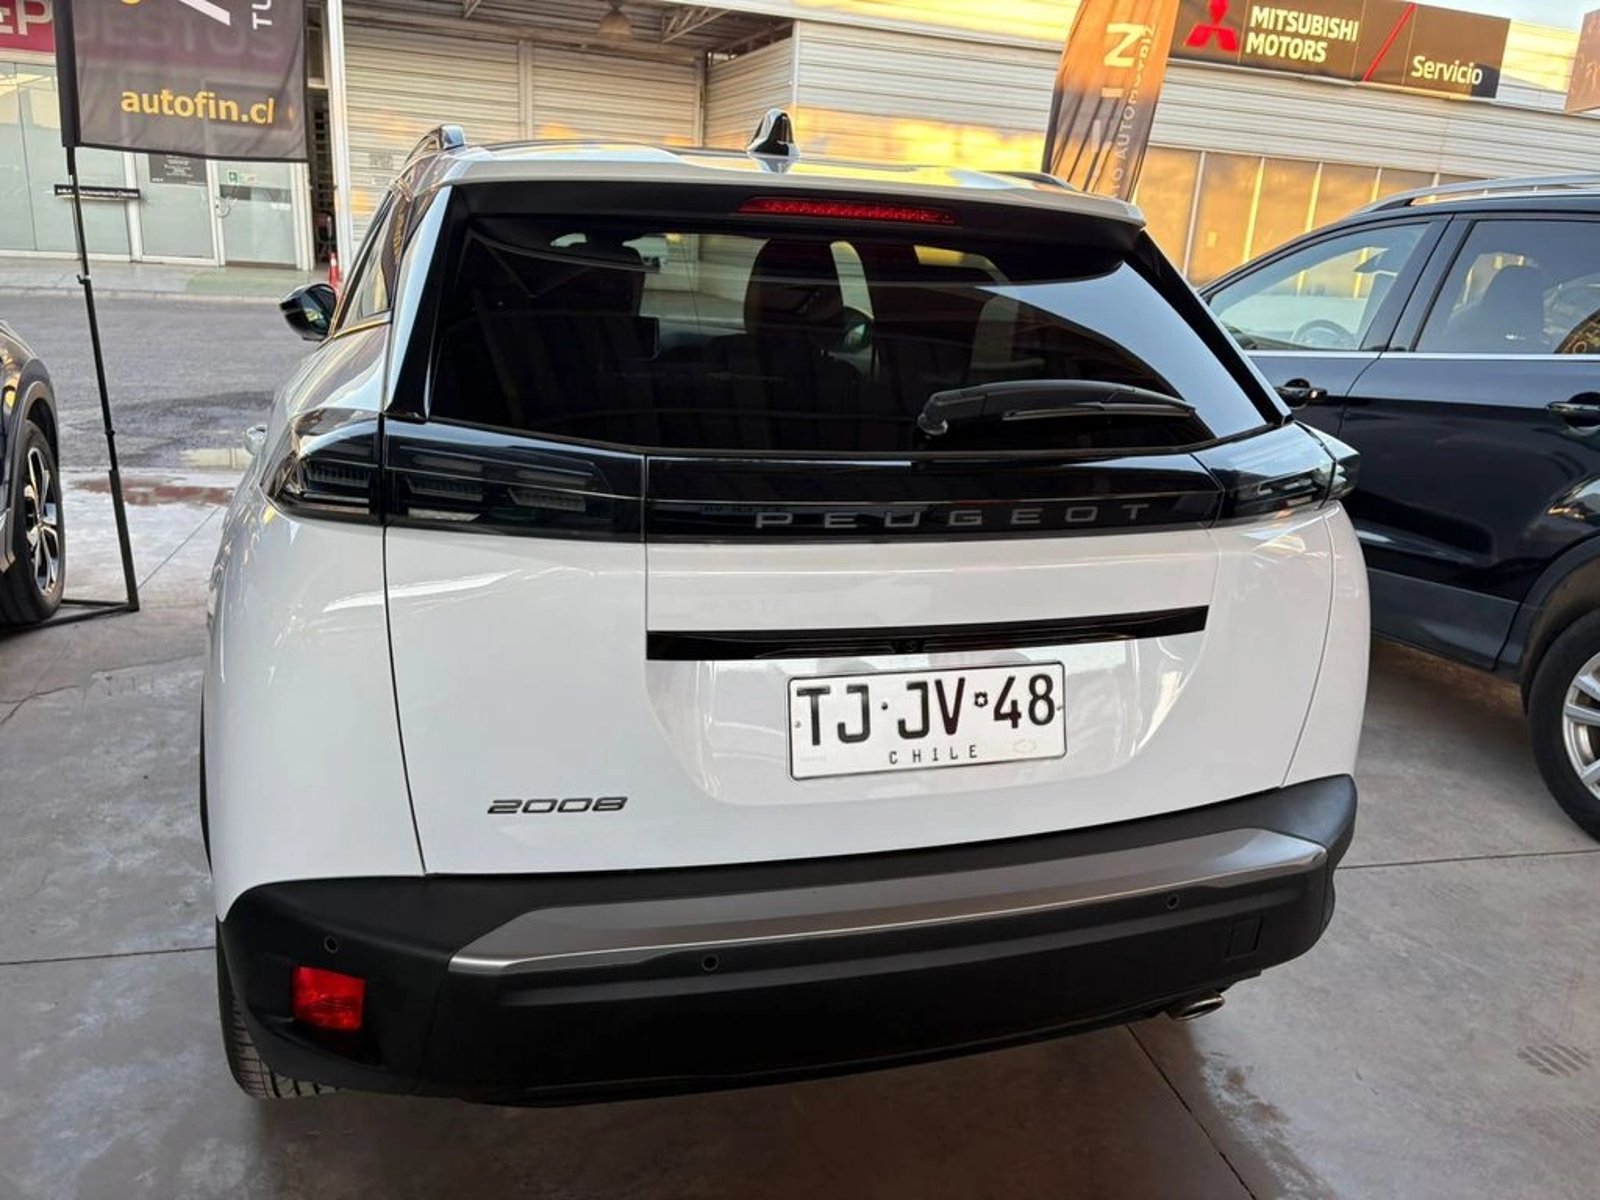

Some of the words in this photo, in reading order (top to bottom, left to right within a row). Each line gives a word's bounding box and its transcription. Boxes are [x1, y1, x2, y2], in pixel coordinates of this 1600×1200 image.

[1250, 5, 1359, 42] MITSUBISHI
[1245, 31, 1328, 63] MOTORS
[1410, 55, 1483, 85] Servicio
[121, 88, 275, 125] autofin.cl
[755, 504, 1149, 529] PEUGEOT
[889, 745, 978, 765] CHILE
[487, 796, 628, 814] 2008
